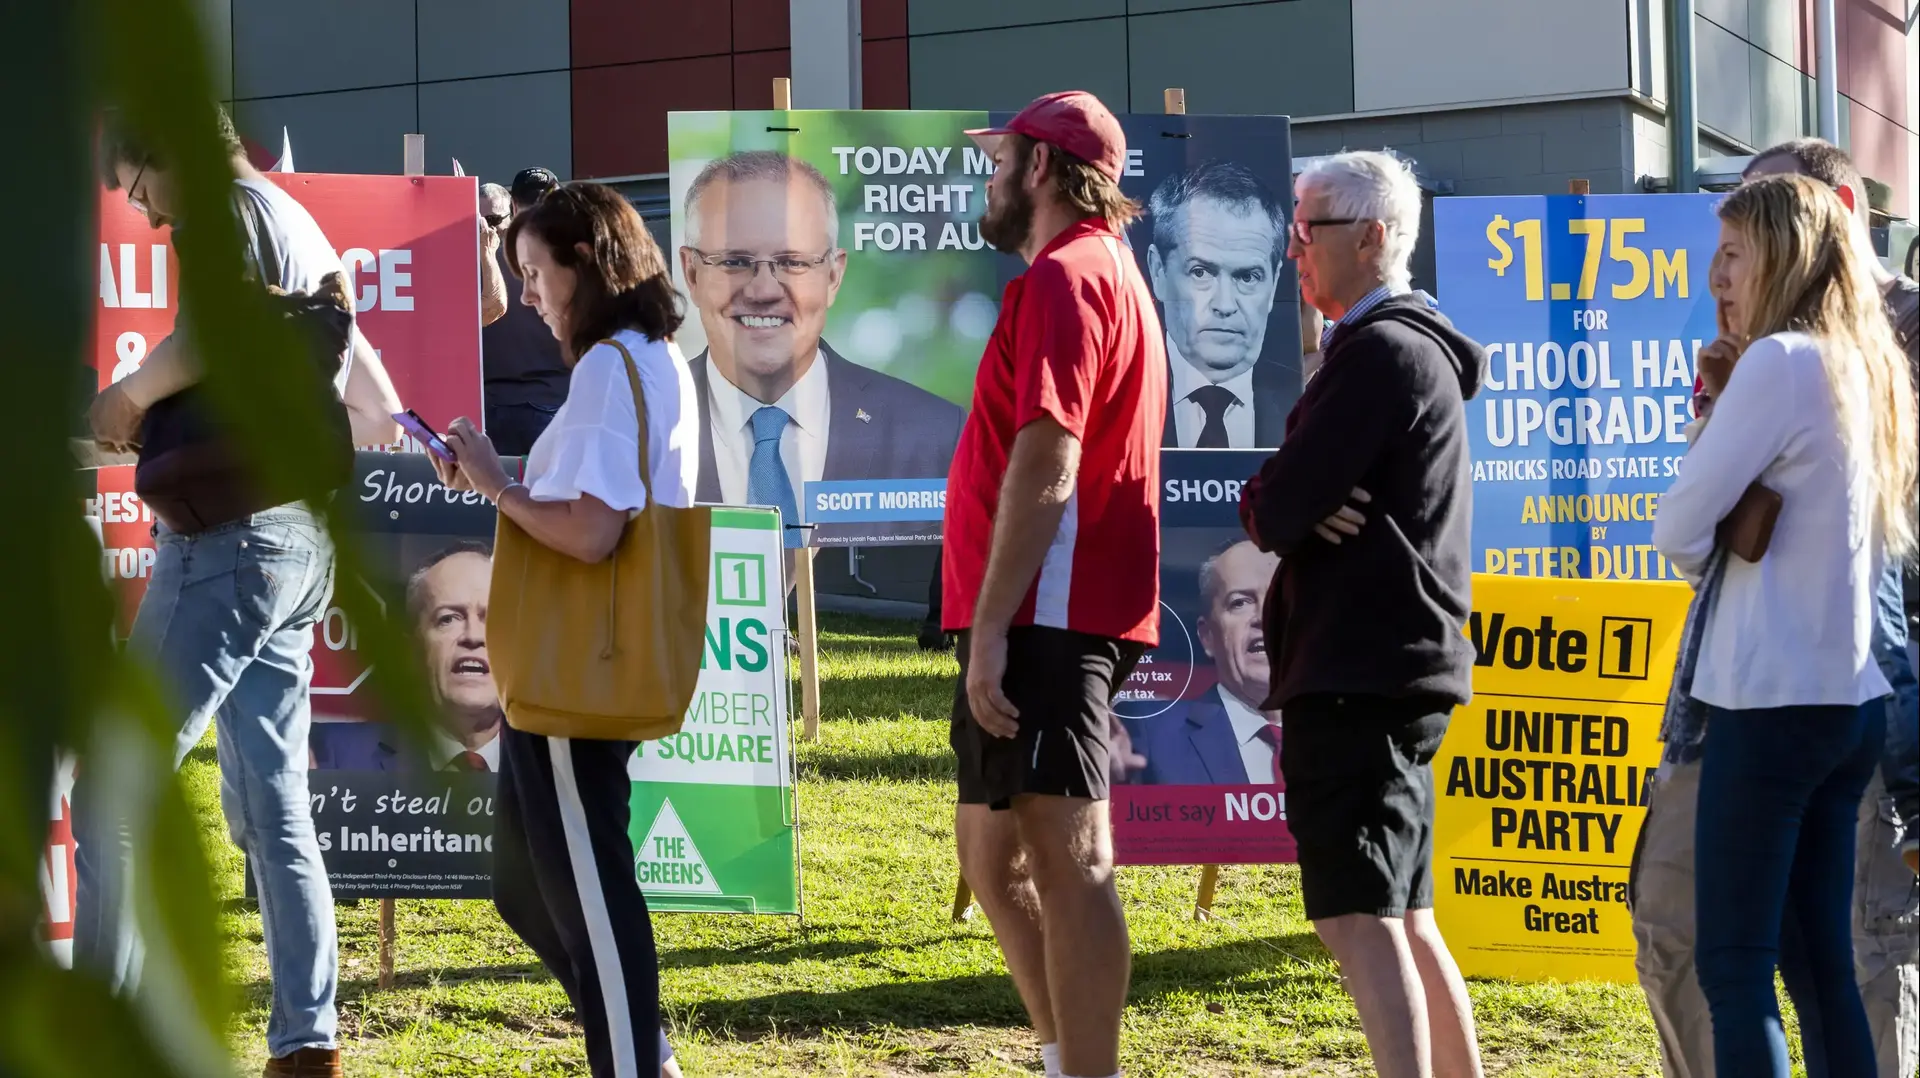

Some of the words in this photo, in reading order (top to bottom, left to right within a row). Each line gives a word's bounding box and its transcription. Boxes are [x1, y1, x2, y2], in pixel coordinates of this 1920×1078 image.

[831, 146, 952, 176] TODAY
[864, 184, 974, 213] RIGHT
[854, 222, 927, 251] FOR
[1486, 214, 1689, 301] $1.75M
[1573, 309, 1608, 331] FOR
[1552, 457, 1602, 480] ROAD
[1607, 456, 1659, 479] STATE
[816, 492, 874, 511] SCOTT
[842, 536, 849, 544] by
[914, 534, 927, 542] Party
[1591, 526, 1607, 540] BY
[1485, 546, 1581, 579] PETER
[1469, 611, 1588, 673] Vote
[1150, 670, 1173, 682] tax
[1134, 688, 1156, 699] tax
[1485, 708, 1630, 758] UNITED
[657, 731, 774, 765] SQUARE
[374, 786, 452, 815] steal
[1125, 801, 1172, 822] Just
[1179, 804, 1217, 827] say
[1224, 791, 1288, 822] NO!
[1491, 806, 1623, 854] PARTY
[653, 836, 686, 859] THE
[338, 882, 345, 890] by
[345, 882, 357, 890] Easy
[357, 882, 371, 891] Signs
[371, 882, 380, 890] Pty
[342, 872, 375, 880] Independent
[374, 872, 402, 881] Third-Party
[636, 861, 704, 885] GREENS
[1454, 867, 1532, 899] Make
[1524, 904, 1600, 935] Great
